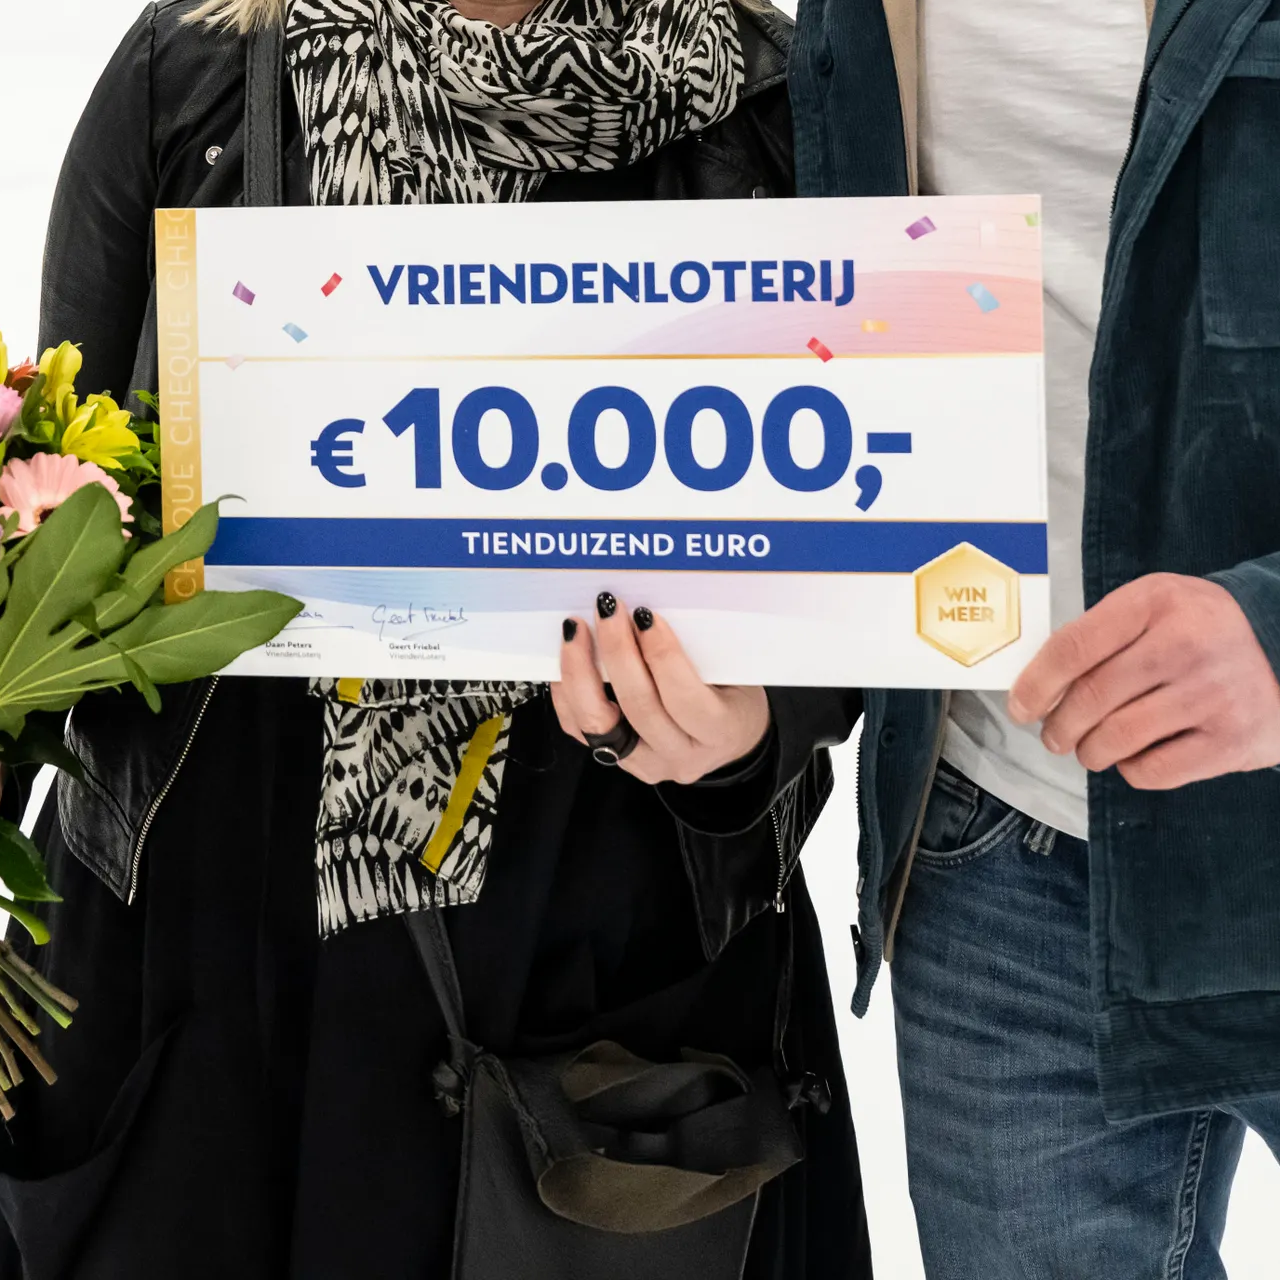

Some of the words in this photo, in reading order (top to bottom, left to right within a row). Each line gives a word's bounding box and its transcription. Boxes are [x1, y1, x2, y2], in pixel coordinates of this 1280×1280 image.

[368, 260, 854, 306] VRIENDENLOTERIJ
[168, 311, 197, 446] CHEQUE
[310, 418, 366, 488] €
[382, 385, 913, 511] 10.000,-
[461, 531, 675, 556] TIENDUIZEND
[686, 533, 771, 558] EURO
[943, 587, 987, 602] WIN
[938, 606, 995, 623] MEER
